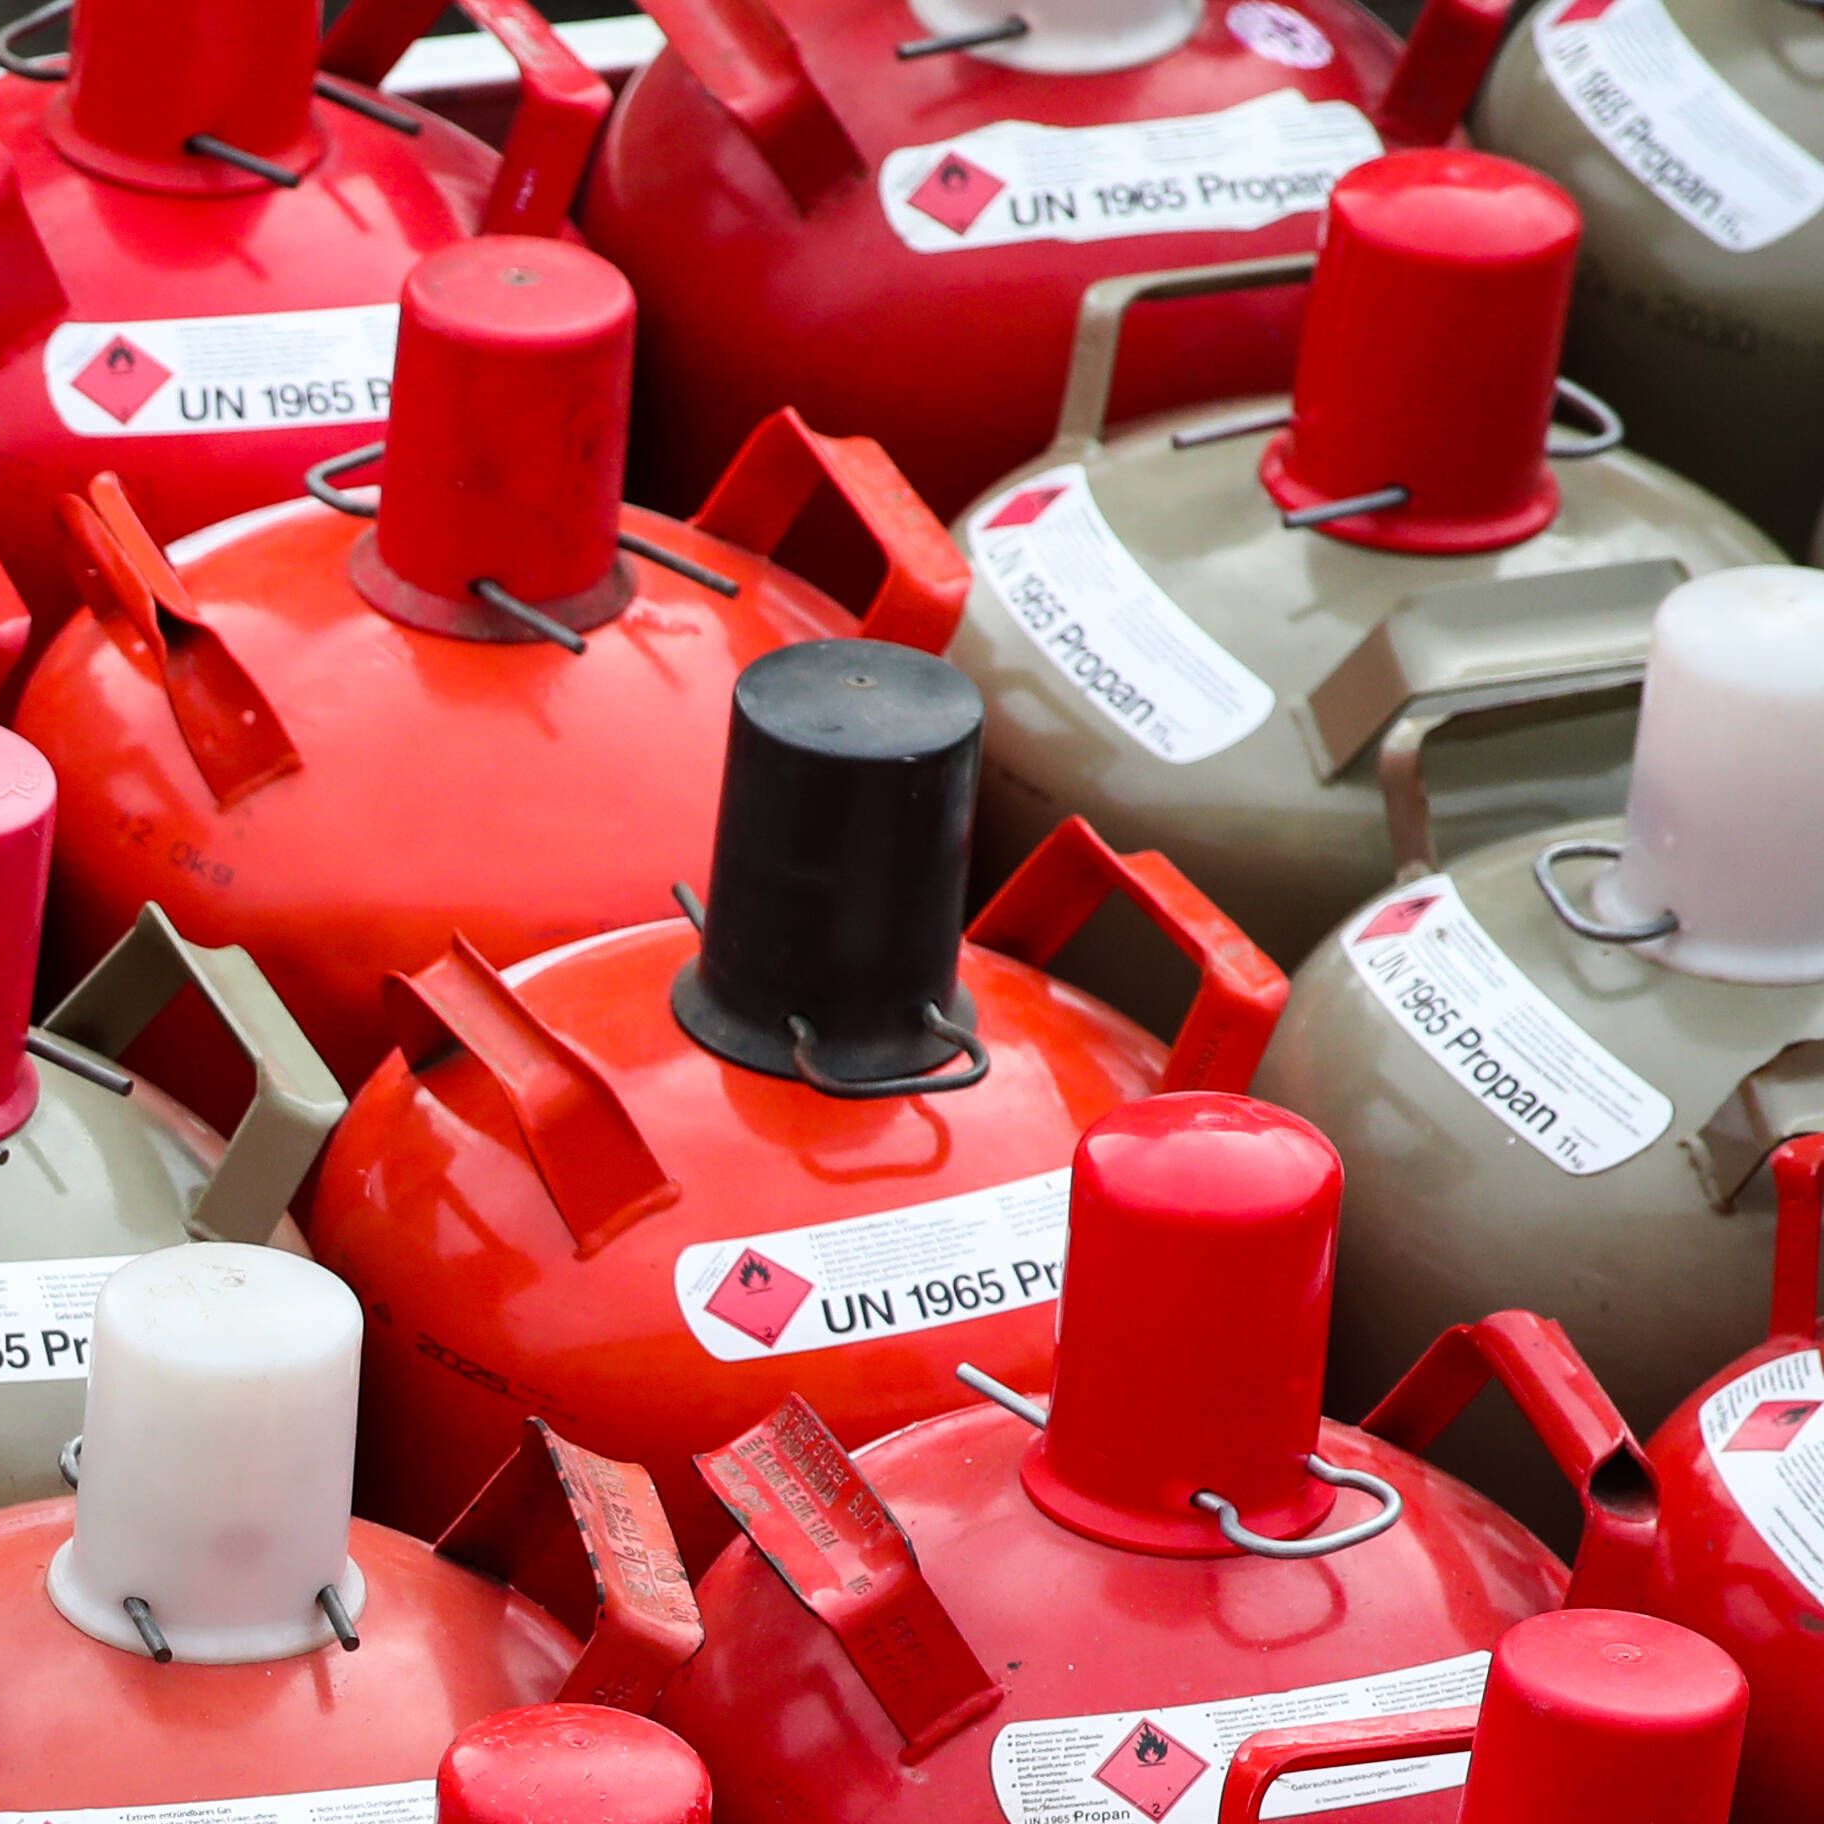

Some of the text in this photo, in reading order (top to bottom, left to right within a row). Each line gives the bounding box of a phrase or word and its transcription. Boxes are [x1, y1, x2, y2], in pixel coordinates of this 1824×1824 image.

[1618, 114, 1723, 215] Propan
[1010, 186, 1078, 230] UN
[1095, 178, 1187, 218] 1965
[178, 378, 355, 424] UN 1965
[1054, 622, 1156, 728] Propan
[1368, 945, 1560, 1138] UN 1965 Propan
[818, 1260, 1066, 1335] UN 1965 Pr
[43, 1328, 90, 1367] Pr
[1073, 1808, 1131, 1824] Propan
